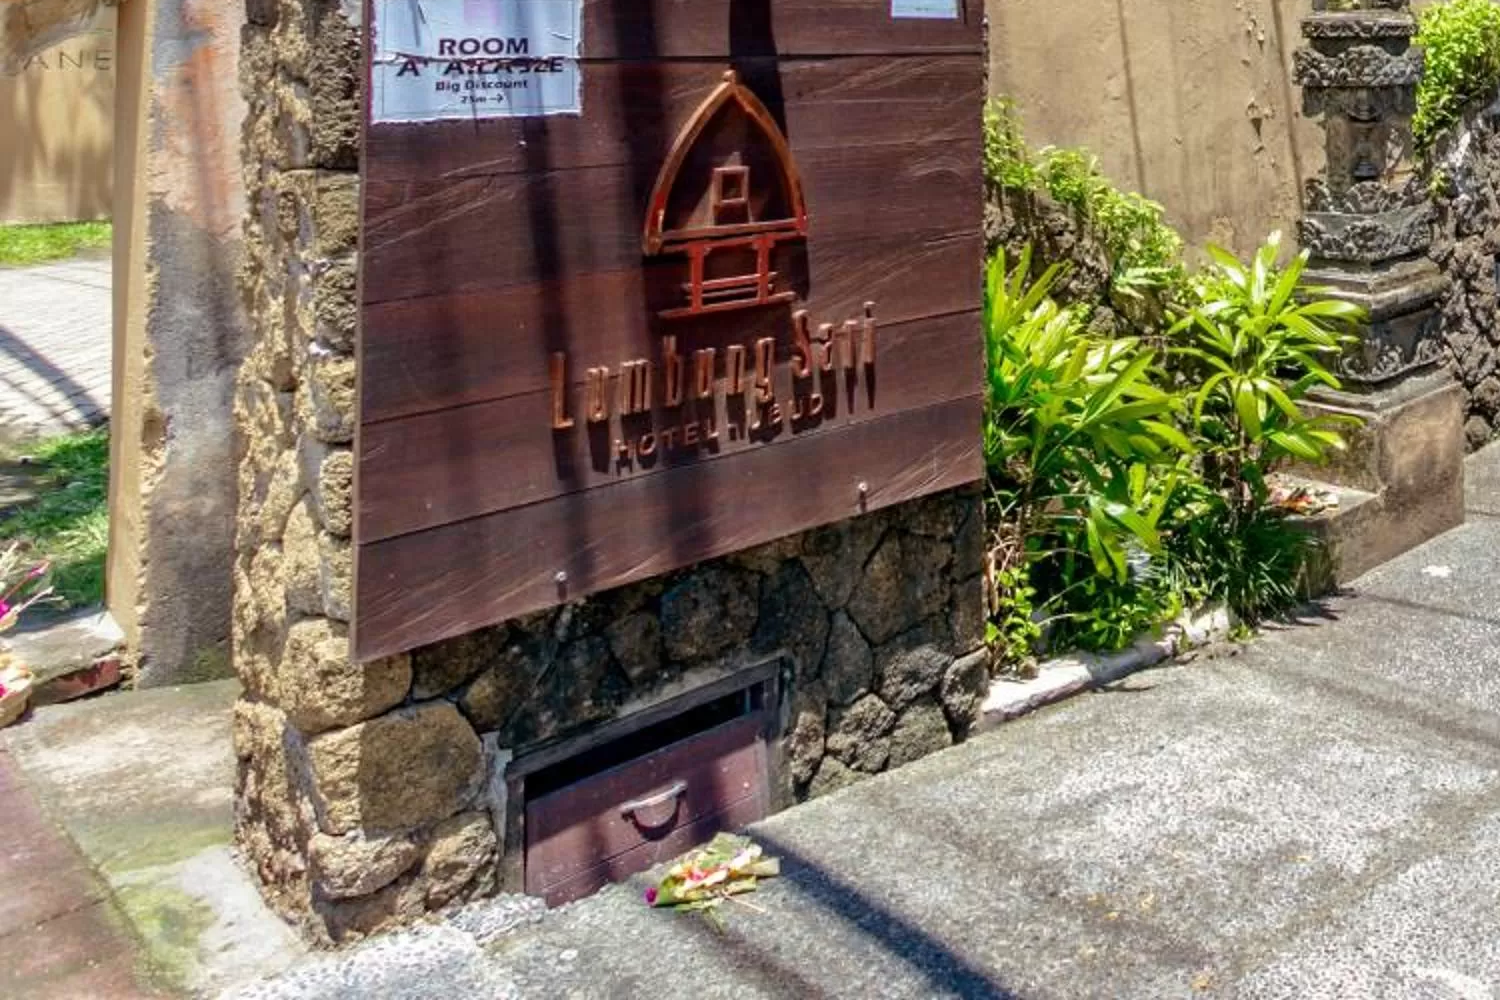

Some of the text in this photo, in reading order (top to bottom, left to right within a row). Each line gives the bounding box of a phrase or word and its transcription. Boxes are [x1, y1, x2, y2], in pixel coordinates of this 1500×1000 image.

[437, 37, 530, 57] ROOM
[551, 301, 877, 430] Lumbung Sari
